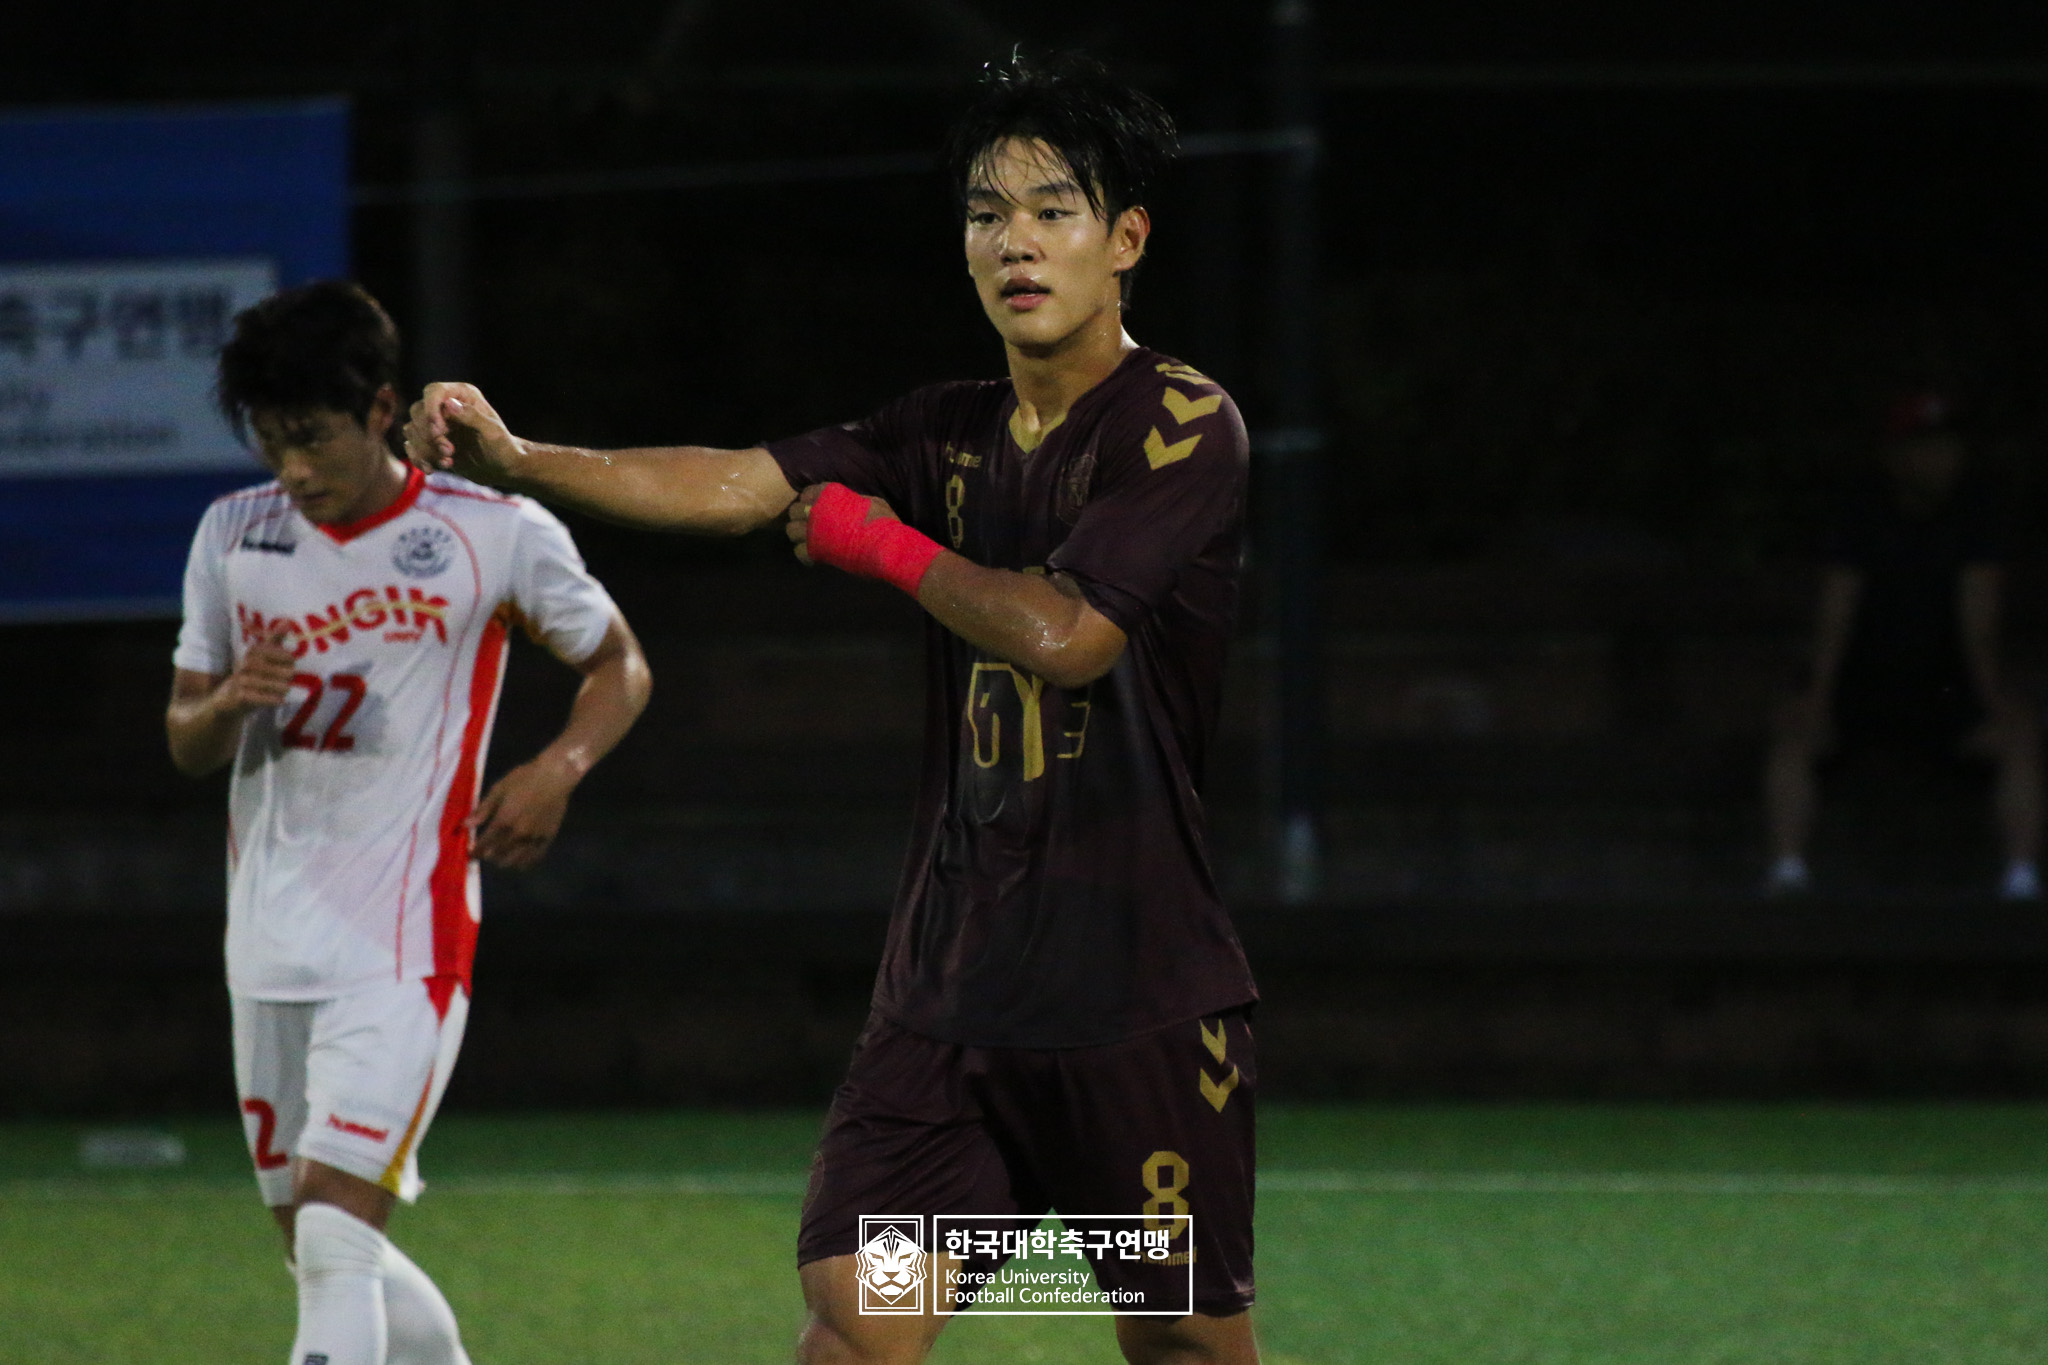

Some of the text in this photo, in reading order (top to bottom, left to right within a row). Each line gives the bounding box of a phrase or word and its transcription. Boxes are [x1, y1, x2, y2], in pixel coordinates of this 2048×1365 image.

[945, 474, 965, 549] 8
[283, 672, 366, 748] 22
[1142, 1150, 1190, 1240] 8
